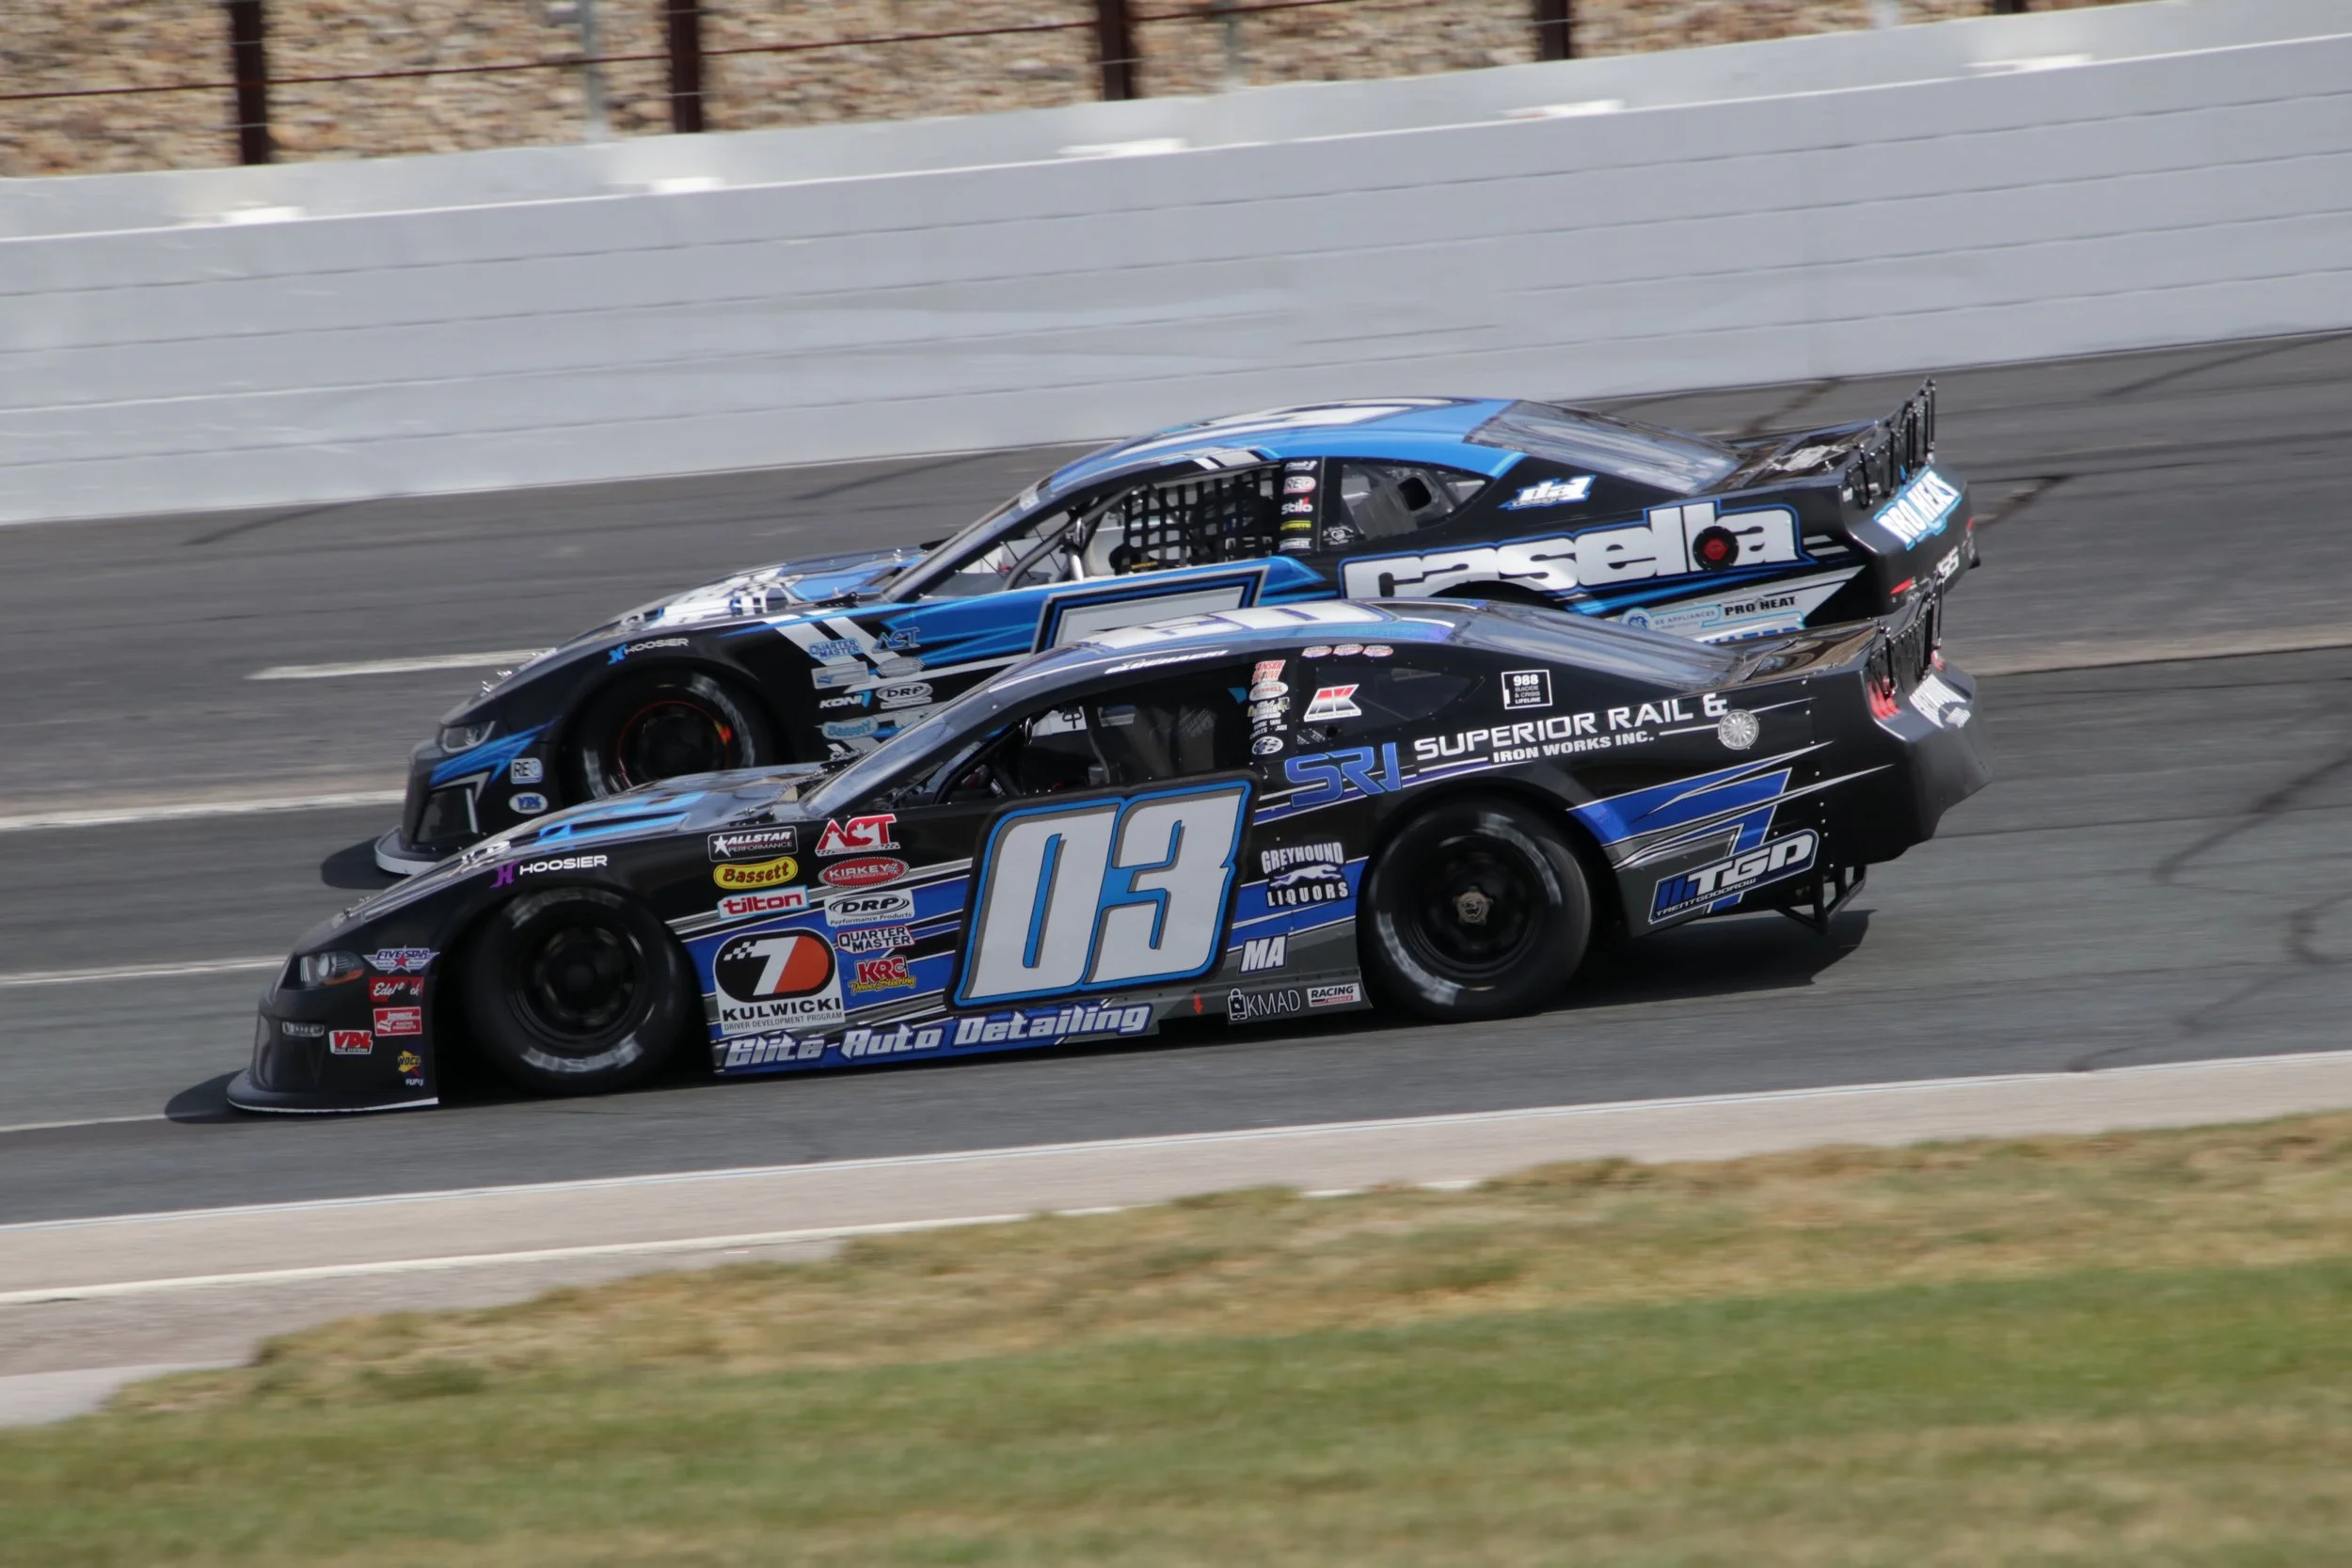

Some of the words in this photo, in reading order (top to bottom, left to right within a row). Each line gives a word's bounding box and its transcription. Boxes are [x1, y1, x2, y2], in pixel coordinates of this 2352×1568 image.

[1906, 470, 1960, 523] HEAT
[1724, 601, 1756, 616] PRO
[1758, 595, 1796, 611] HEAT
[623, 638, 689, 655] HOOSIER
[808, 639, 857, 656] QUARTER
[819, 646, 860, 657] MASTER
[1513, 673, 1539, 687] 988
[818, 695, 862, 709] KONI
[887, 686, 924, 698] DRP
[1414, 712, 1597, 761] SUPERIOR
[1607, 699, 1693, 731] RAIL
[1703, 692, 1728, 718] &
[1493, 747, 1540, 764] IRON
[1544, 734, 1613, 757] WORKS
[1615, 729, 1655, 746] INC.
[725, 832, 791, 846] ALLSTAR
[816, 815, 897, 851] ACT
[727, 840, 792, 853] PERFORMANCE
[519, 854, 608, 876] HOOSIER
[1261, 841, 1344, 875] GREYHOUND
[723, 862, 789, 884] Bassett
[829, 863, 890, 879] KIRKEY
[723, 893, 803, 915] tilton
[958, 783, 1251, 1006] 03
[1266, 881, 1349, 907] LIQUORS
[840, 895, 899, 914] DRP
[830, 915, 878, 927] Performance
[879, 911, 913, 921] Products
[838, 927, 906, 947] QUARTER
[852, 934, 911, 952] MASTER
[377, 949, 403, 959] FIVE
[405, 948, 430, 959] STAR
[1240, 935, 1287, 973] MA
[751, 935, 800, 996] 7
[857, 957, 907, 985] KRC
[373, 981, 421, 997] Edelck
[1311, 985, 1354, 999] RACING
[723, 997, 841, 1022] KULWICKI
[1247, 989, 1301, 1017] KMAD
[723, 1021, 752, 1031] DRIVER
[752, 1016, 805, 1028] DEVELOPMENT
[806, 1011, 843, 1022] PROGRAM
[724, 1031, 828, 1069] Elite
[840, 1022, 944, 1061] Auto
[953, 1003, 1152, 1047] Detailing
